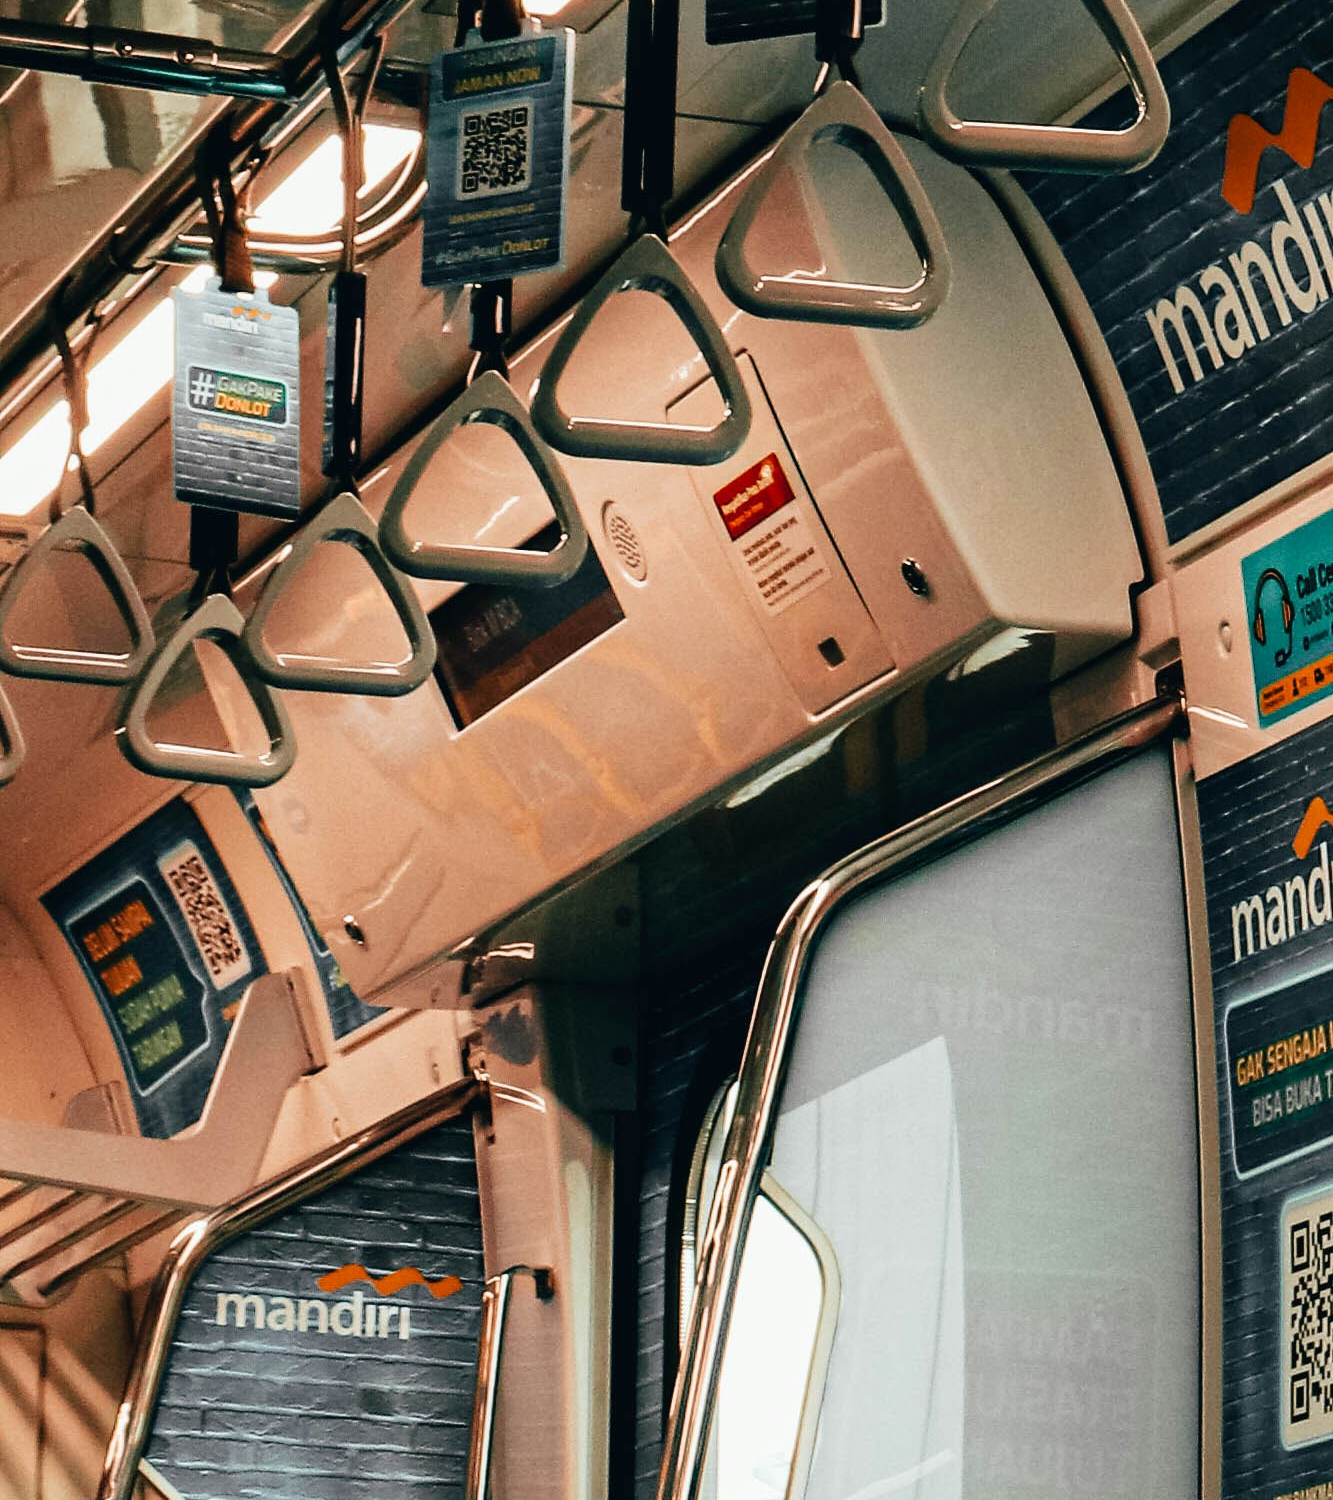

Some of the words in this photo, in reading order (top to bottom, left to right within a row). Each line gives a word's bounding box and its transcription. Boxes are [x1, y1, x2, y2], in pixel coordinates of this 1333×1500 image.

[214, 392, 272, 418] DONLOT
[1295, 565, 1318, 600] Call
[1236, 1049, 1264, 1088] GAK
[1266, 1025, 1327, 1077] SENGAJA
[1252, 1088, 1283, 1128] BISA
[1284, 1071, 1322, 1114] BUKA
[215, 1290, 412, 1342] mandiri
